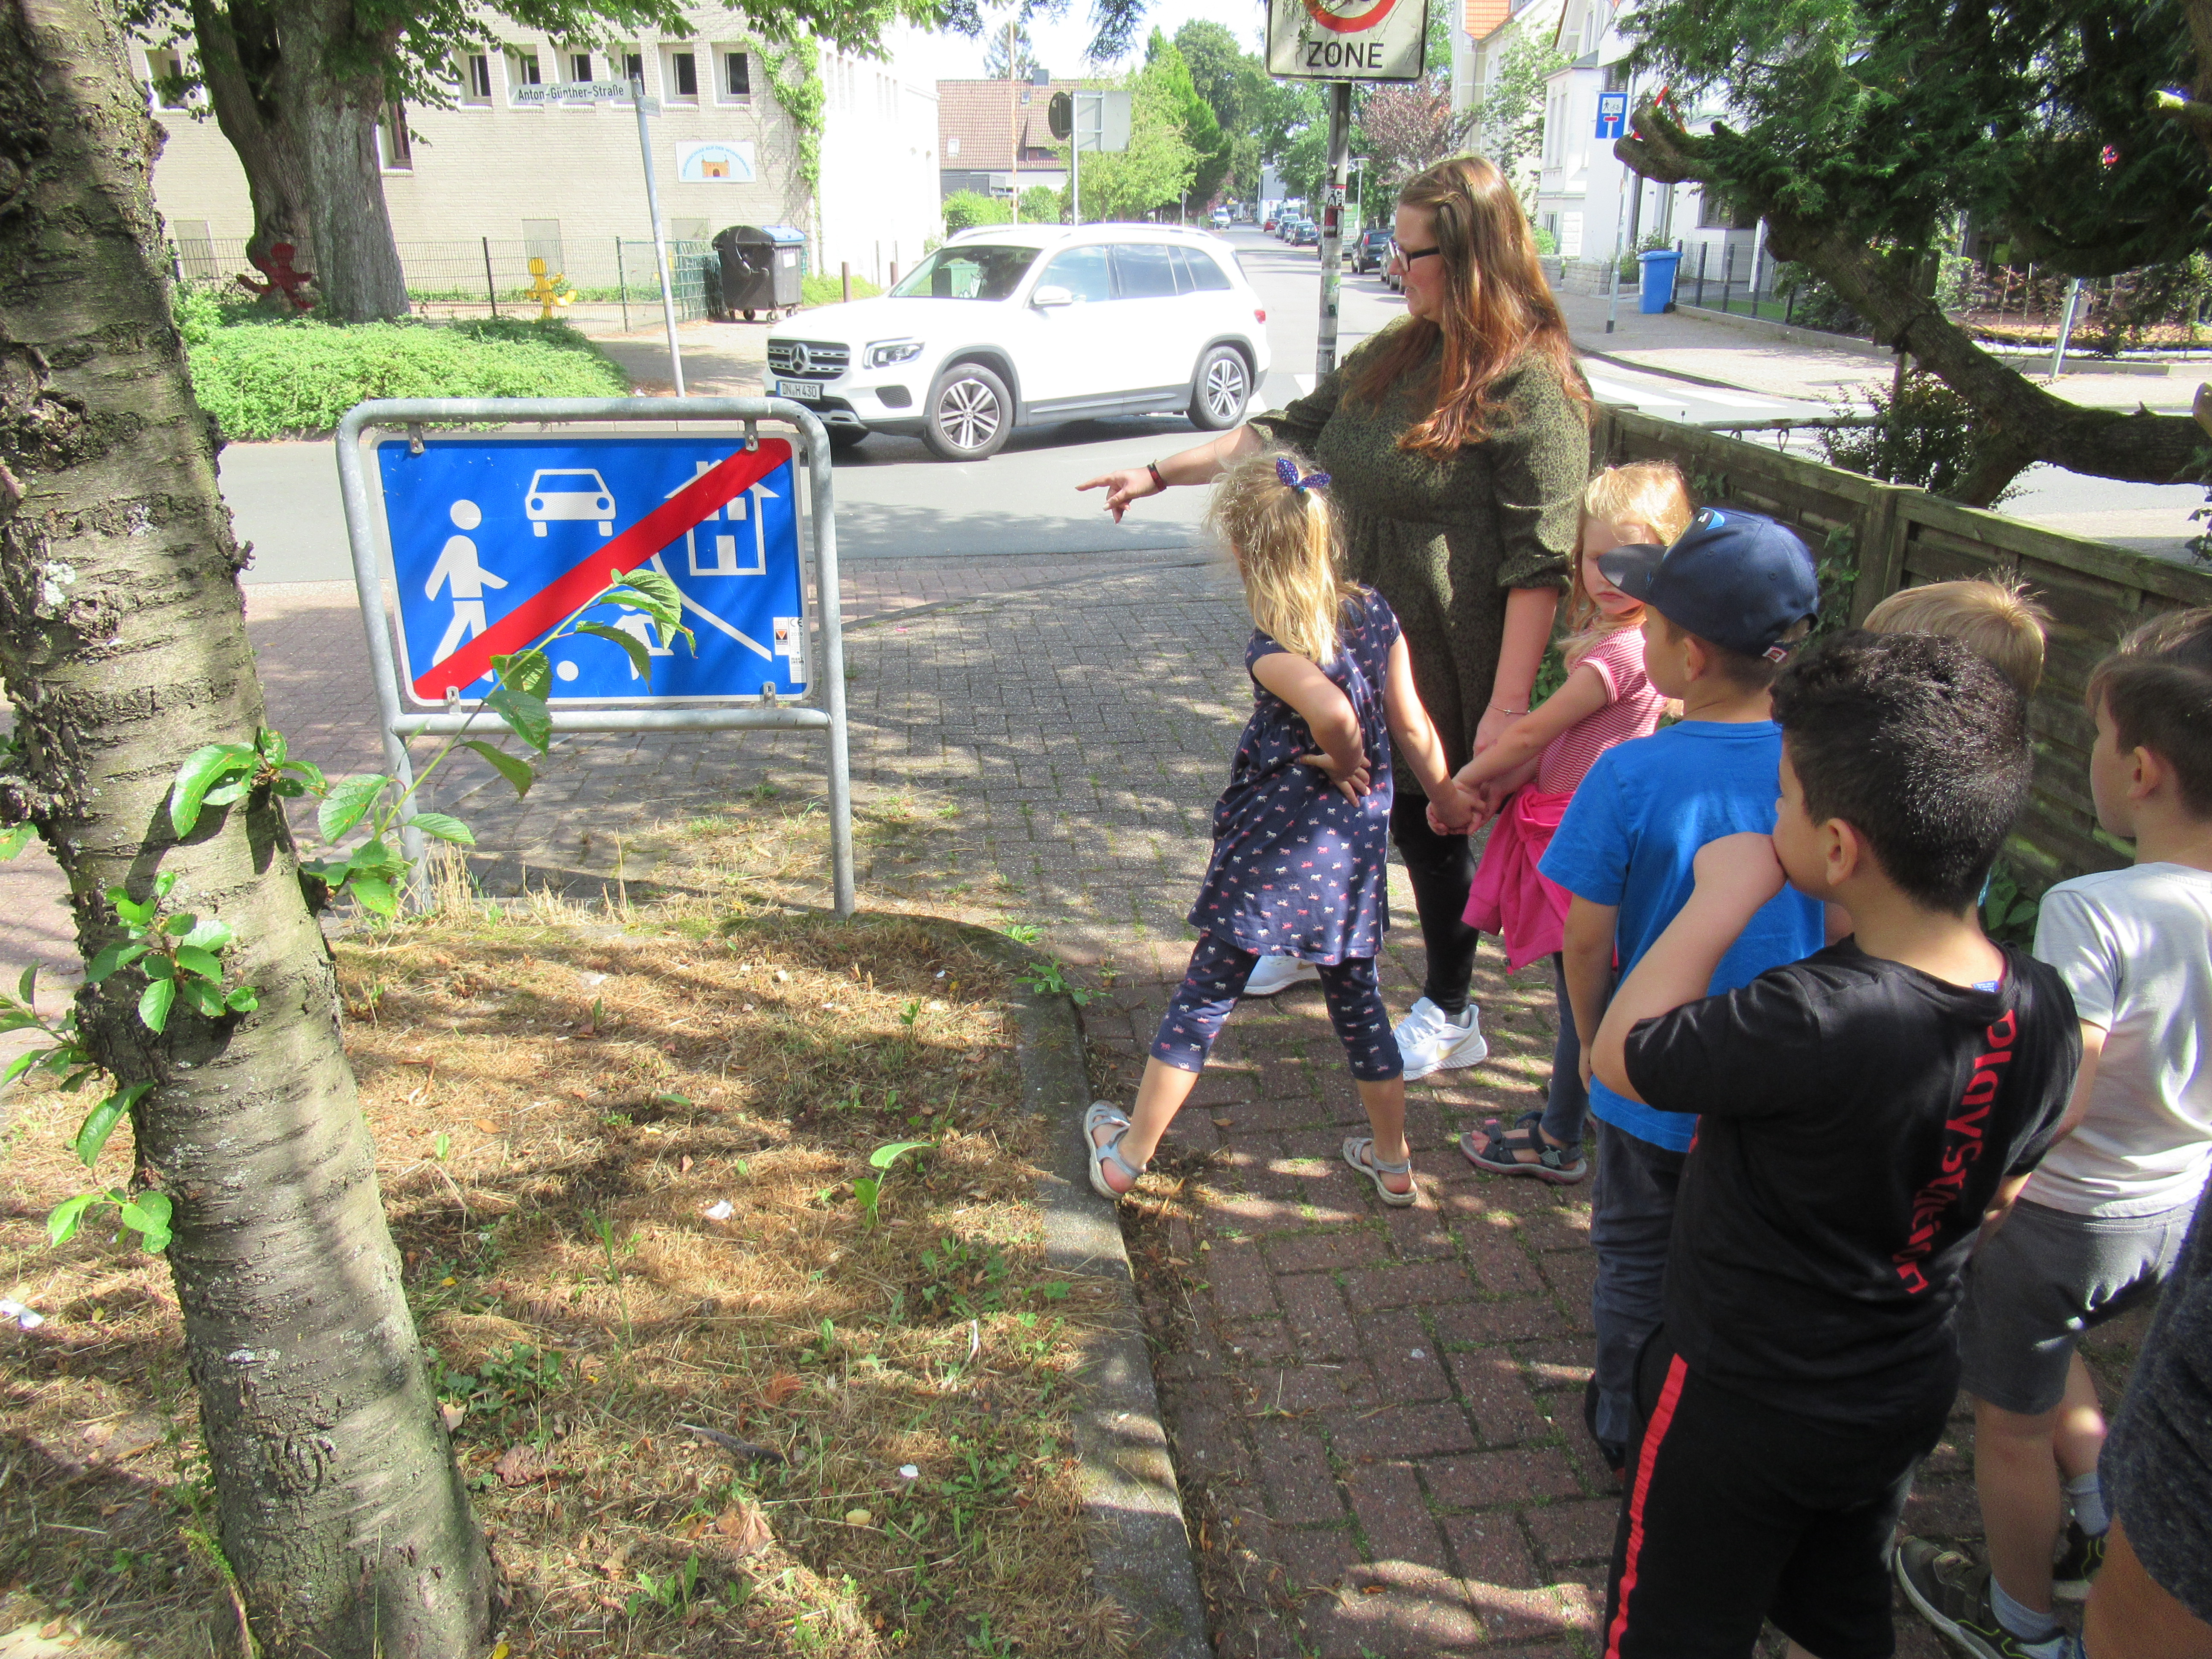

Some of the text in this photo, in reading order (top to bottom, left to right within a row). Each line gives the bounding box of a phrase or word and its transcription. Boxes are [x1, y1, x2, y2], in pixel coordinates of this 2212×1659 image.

[1306, 41, 1384, 69] ZONE
[518, 84, 624, 101] Anton-Günther-Straße
[683, 148, 705, 177] GRUNDSCHULE
[725, 148, 751, 176] WUNDERBURG
